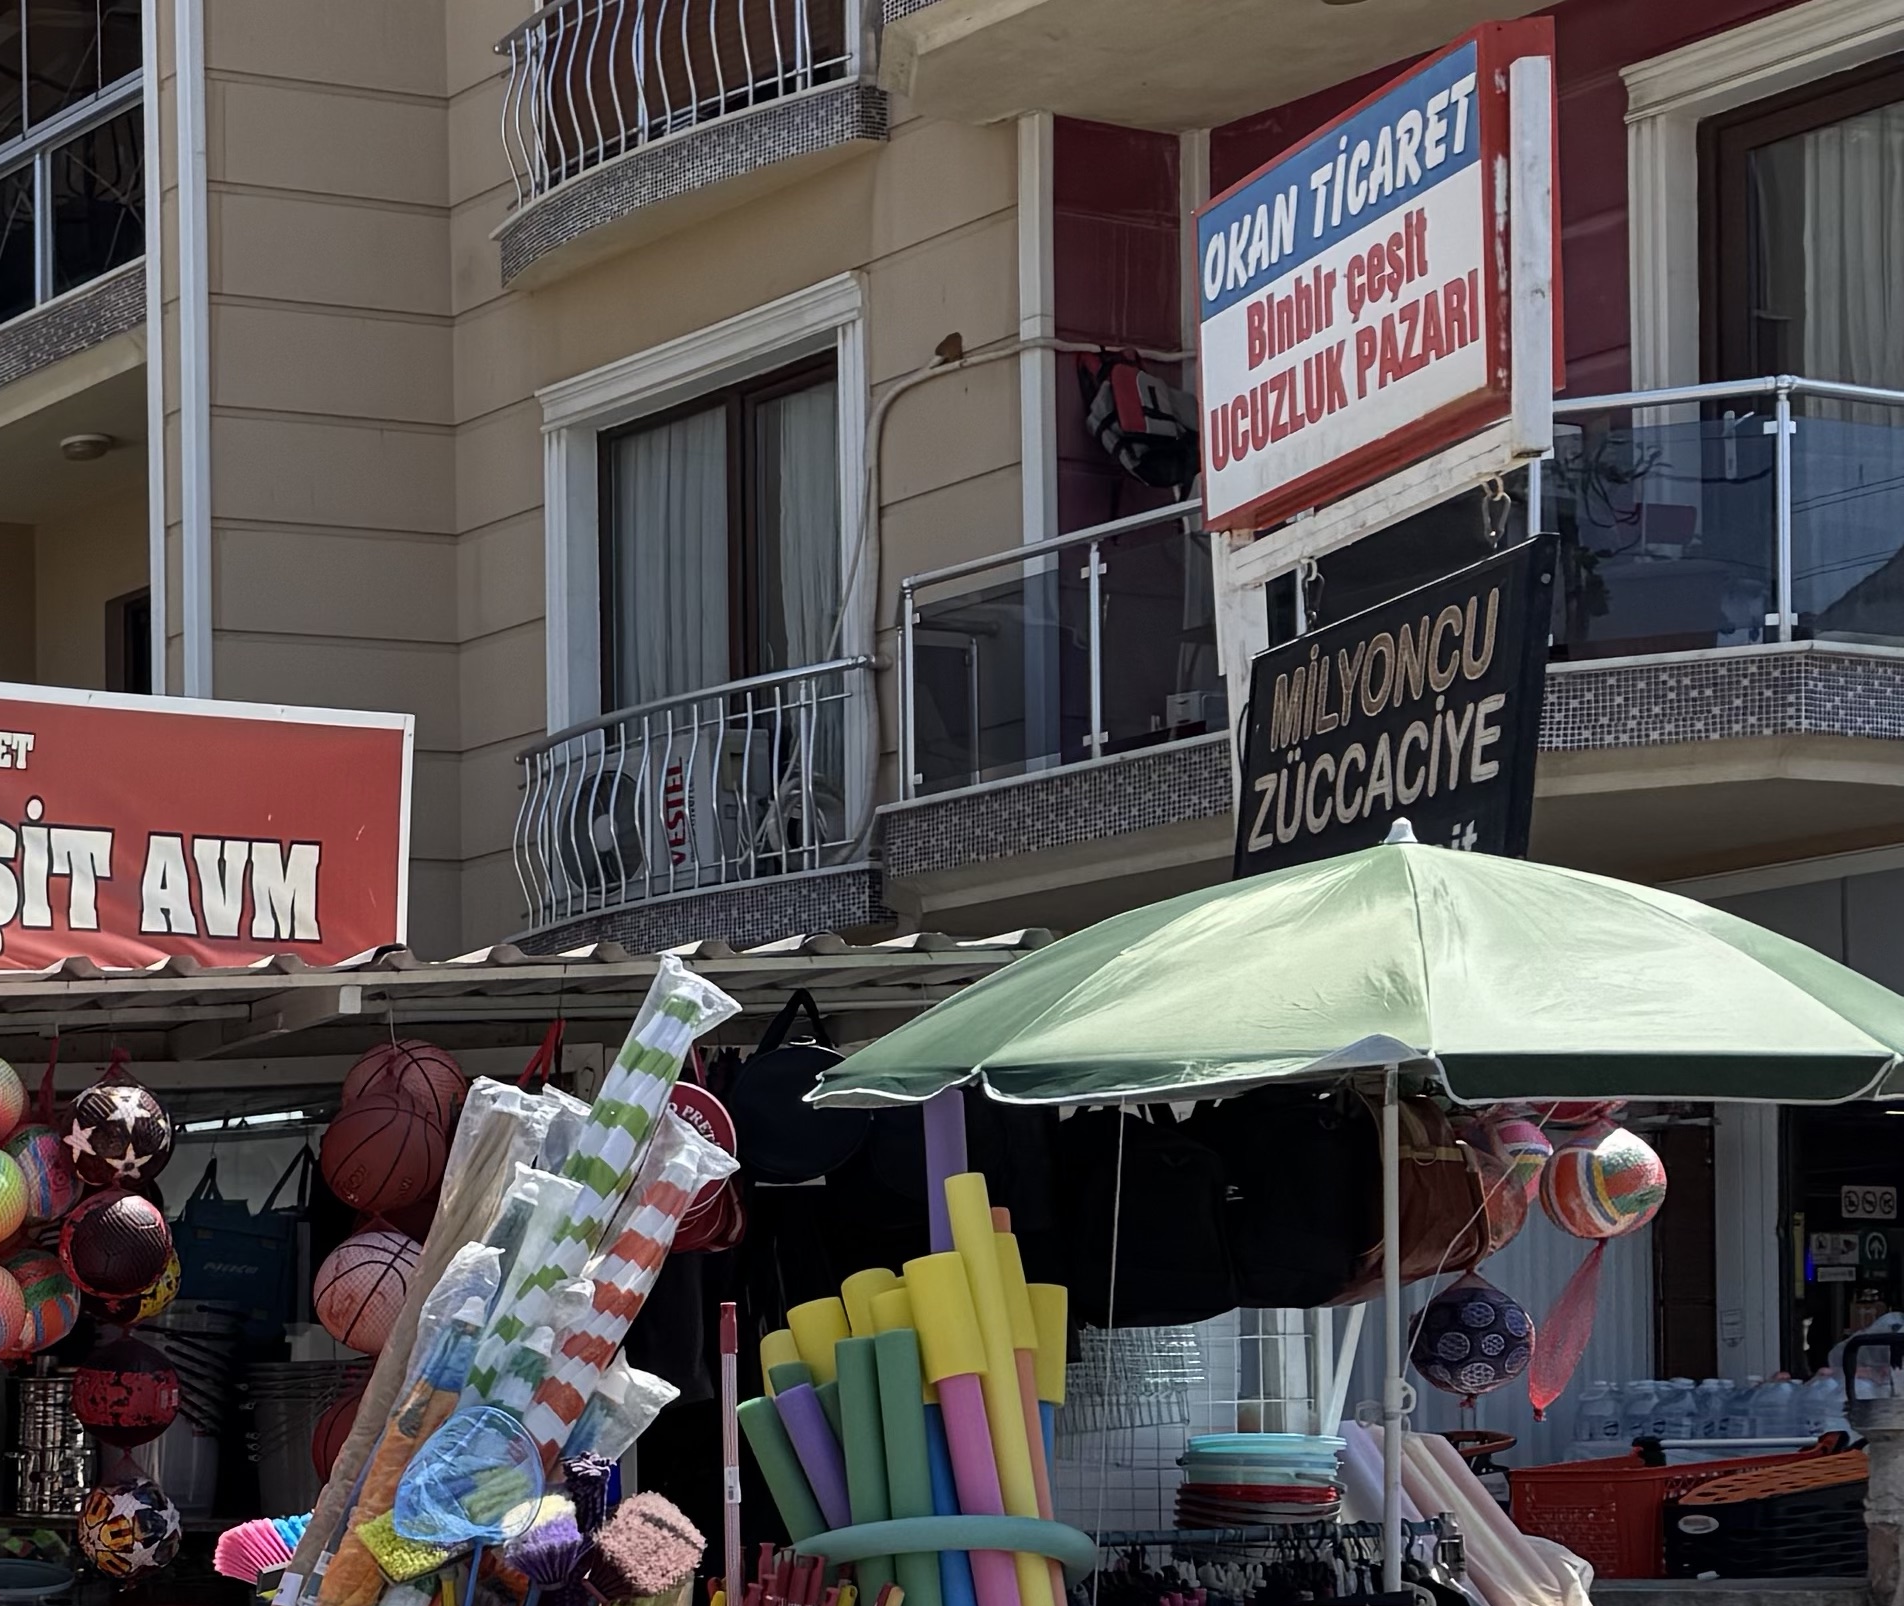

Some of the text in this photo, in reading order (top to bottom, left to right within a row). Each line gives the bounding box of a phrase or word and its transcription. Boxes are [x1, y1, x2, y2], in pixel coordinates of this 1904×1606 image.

[1204, 72, 1477, 301] OKAN TİCARET
[1210, 267, 1480, 471] UCUZLUK PAZARI
[1270, 586, 1500, 752] MİLYONCU
[1247, 693, 1506, 853] ZÜCCACİYE
[139, 831, 323, 942] AVM
